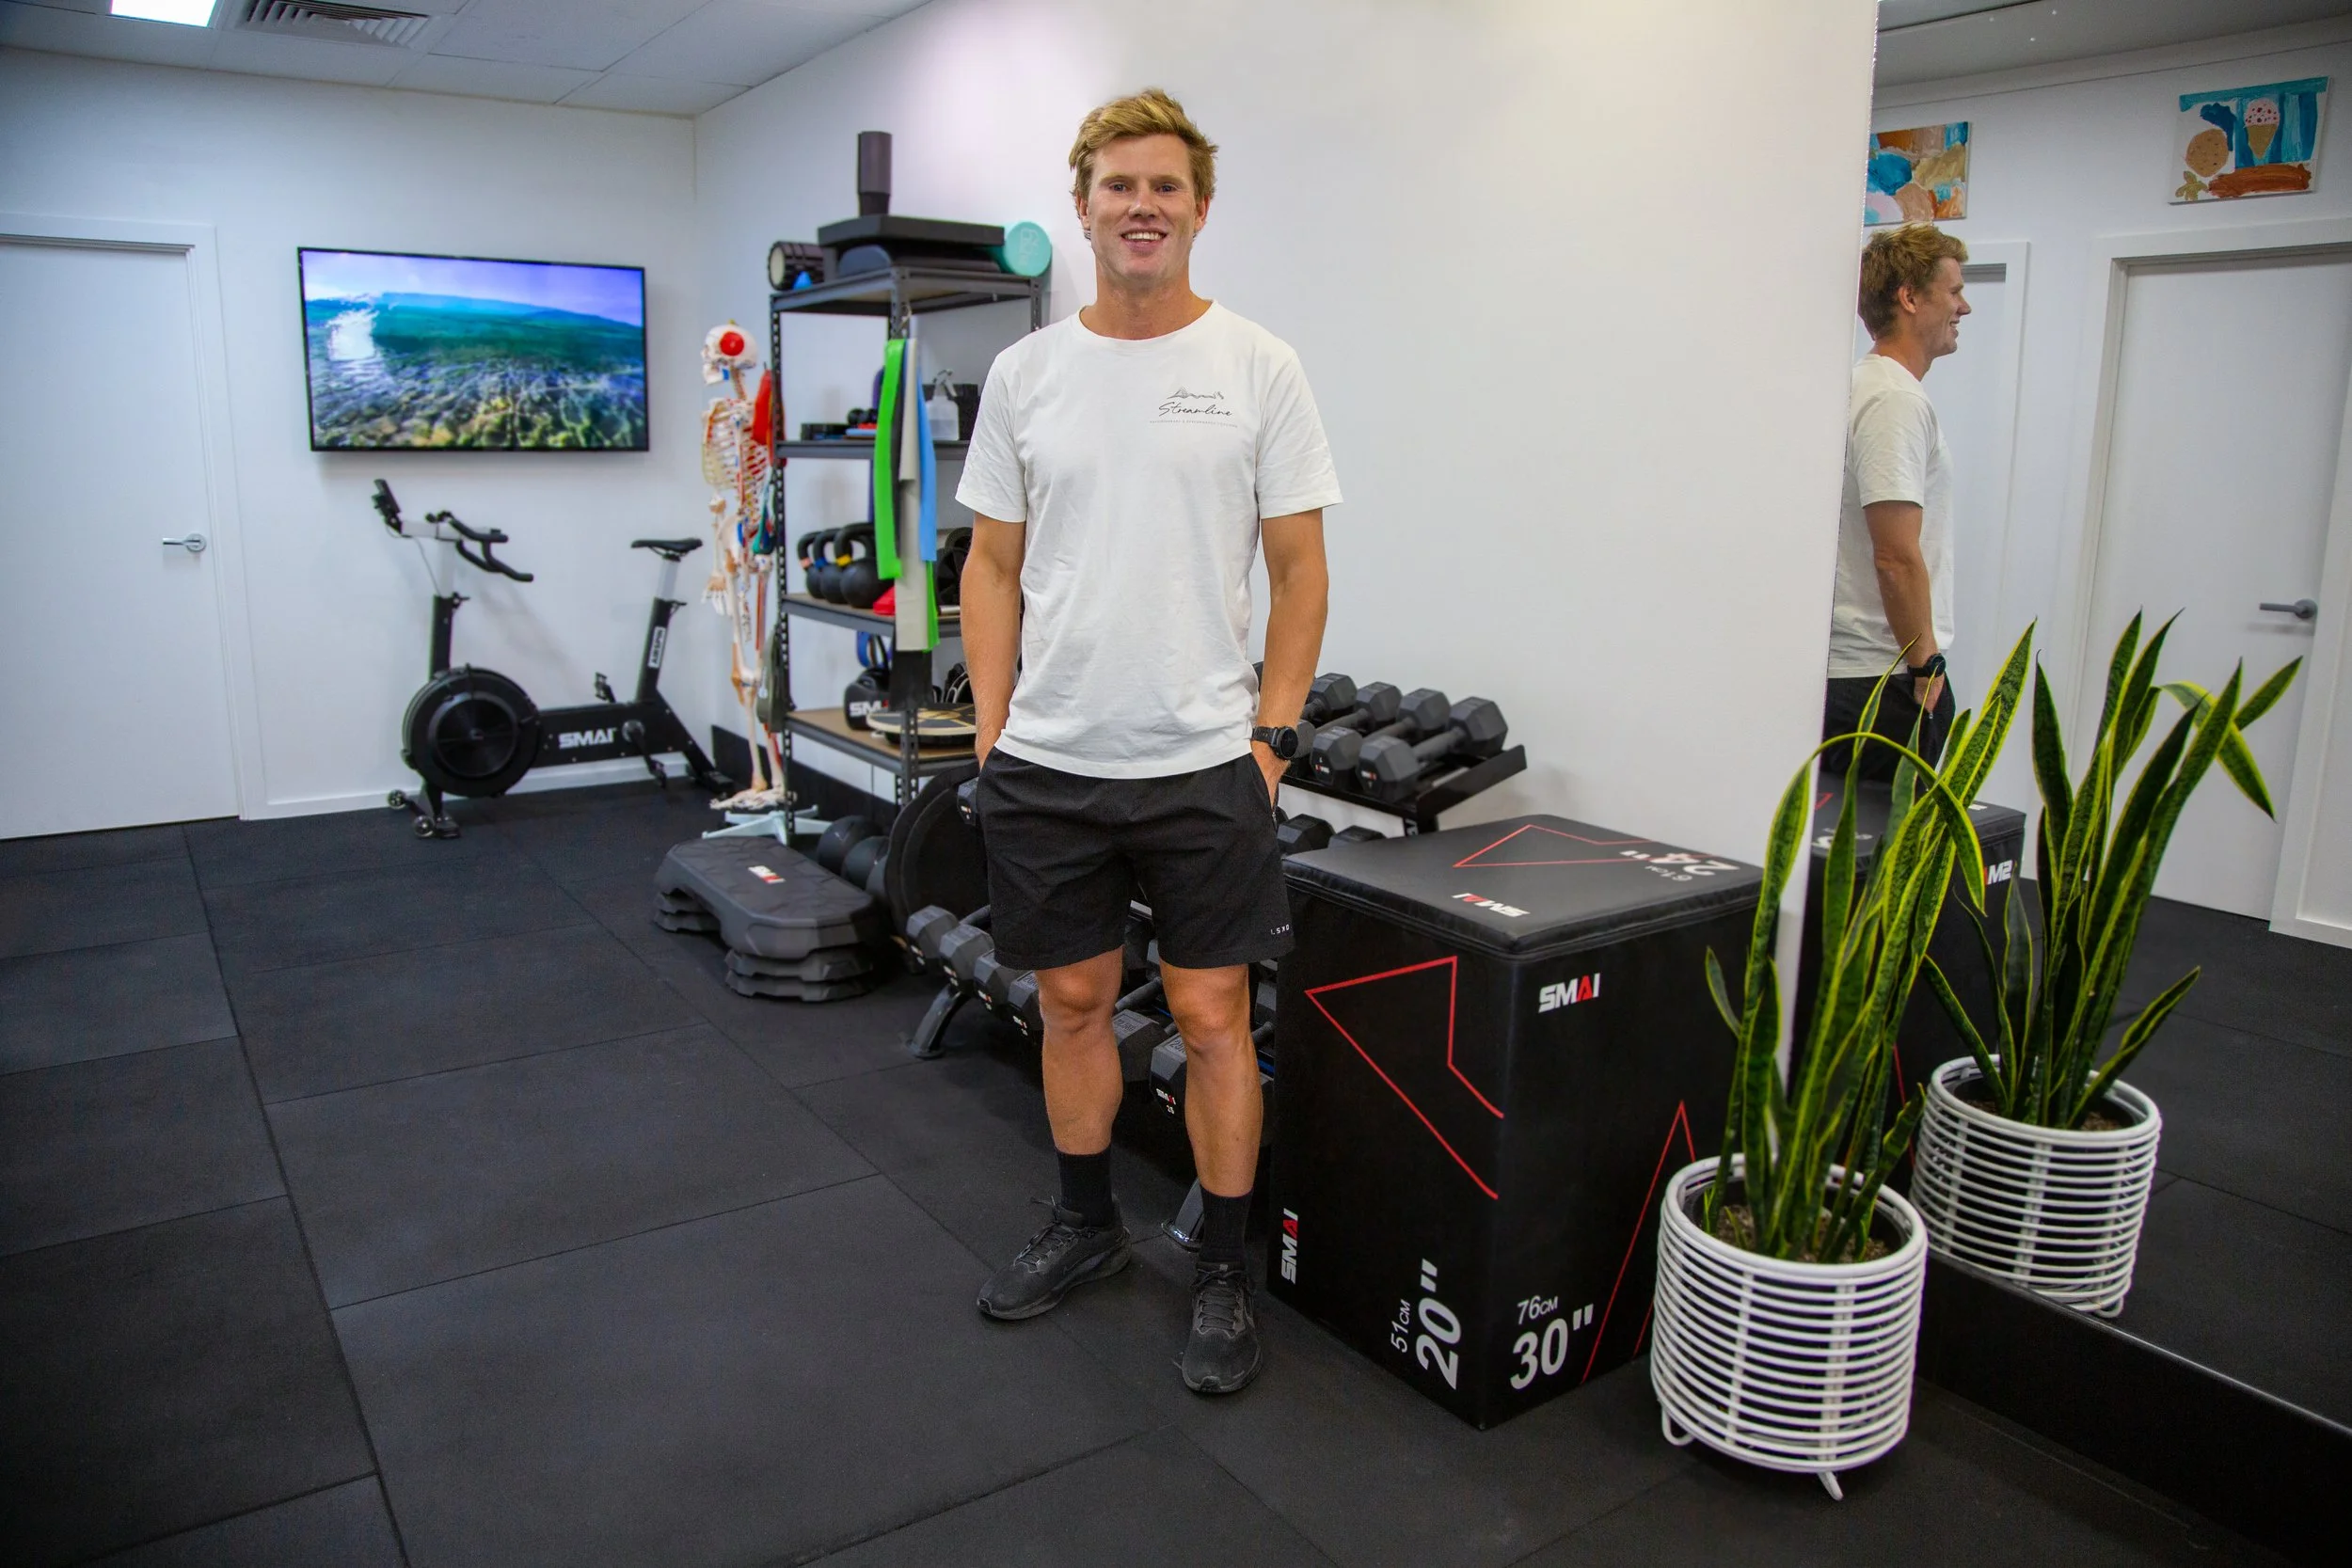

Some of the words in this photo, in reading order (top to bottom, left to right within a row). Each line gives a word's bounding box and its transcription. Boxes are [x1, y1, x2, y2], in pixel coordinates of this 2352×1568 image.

[1158, 401, 1232, 417] Streamline
[558, 727, 616, 750] SMAI
[1451, 893, 1531, 918] SMAI
[1538, 973, 1601, 1013] SMAI
[1281, 1208, 1298, 1285] SMAI
[1391, 1299, 1411, 1353] 51CM
[1416, 1258, 1462, 1390] 20"
[1517, 1294, 1559, 1325] 76CM
[1510, 1304, 1594, 1390] 30"
